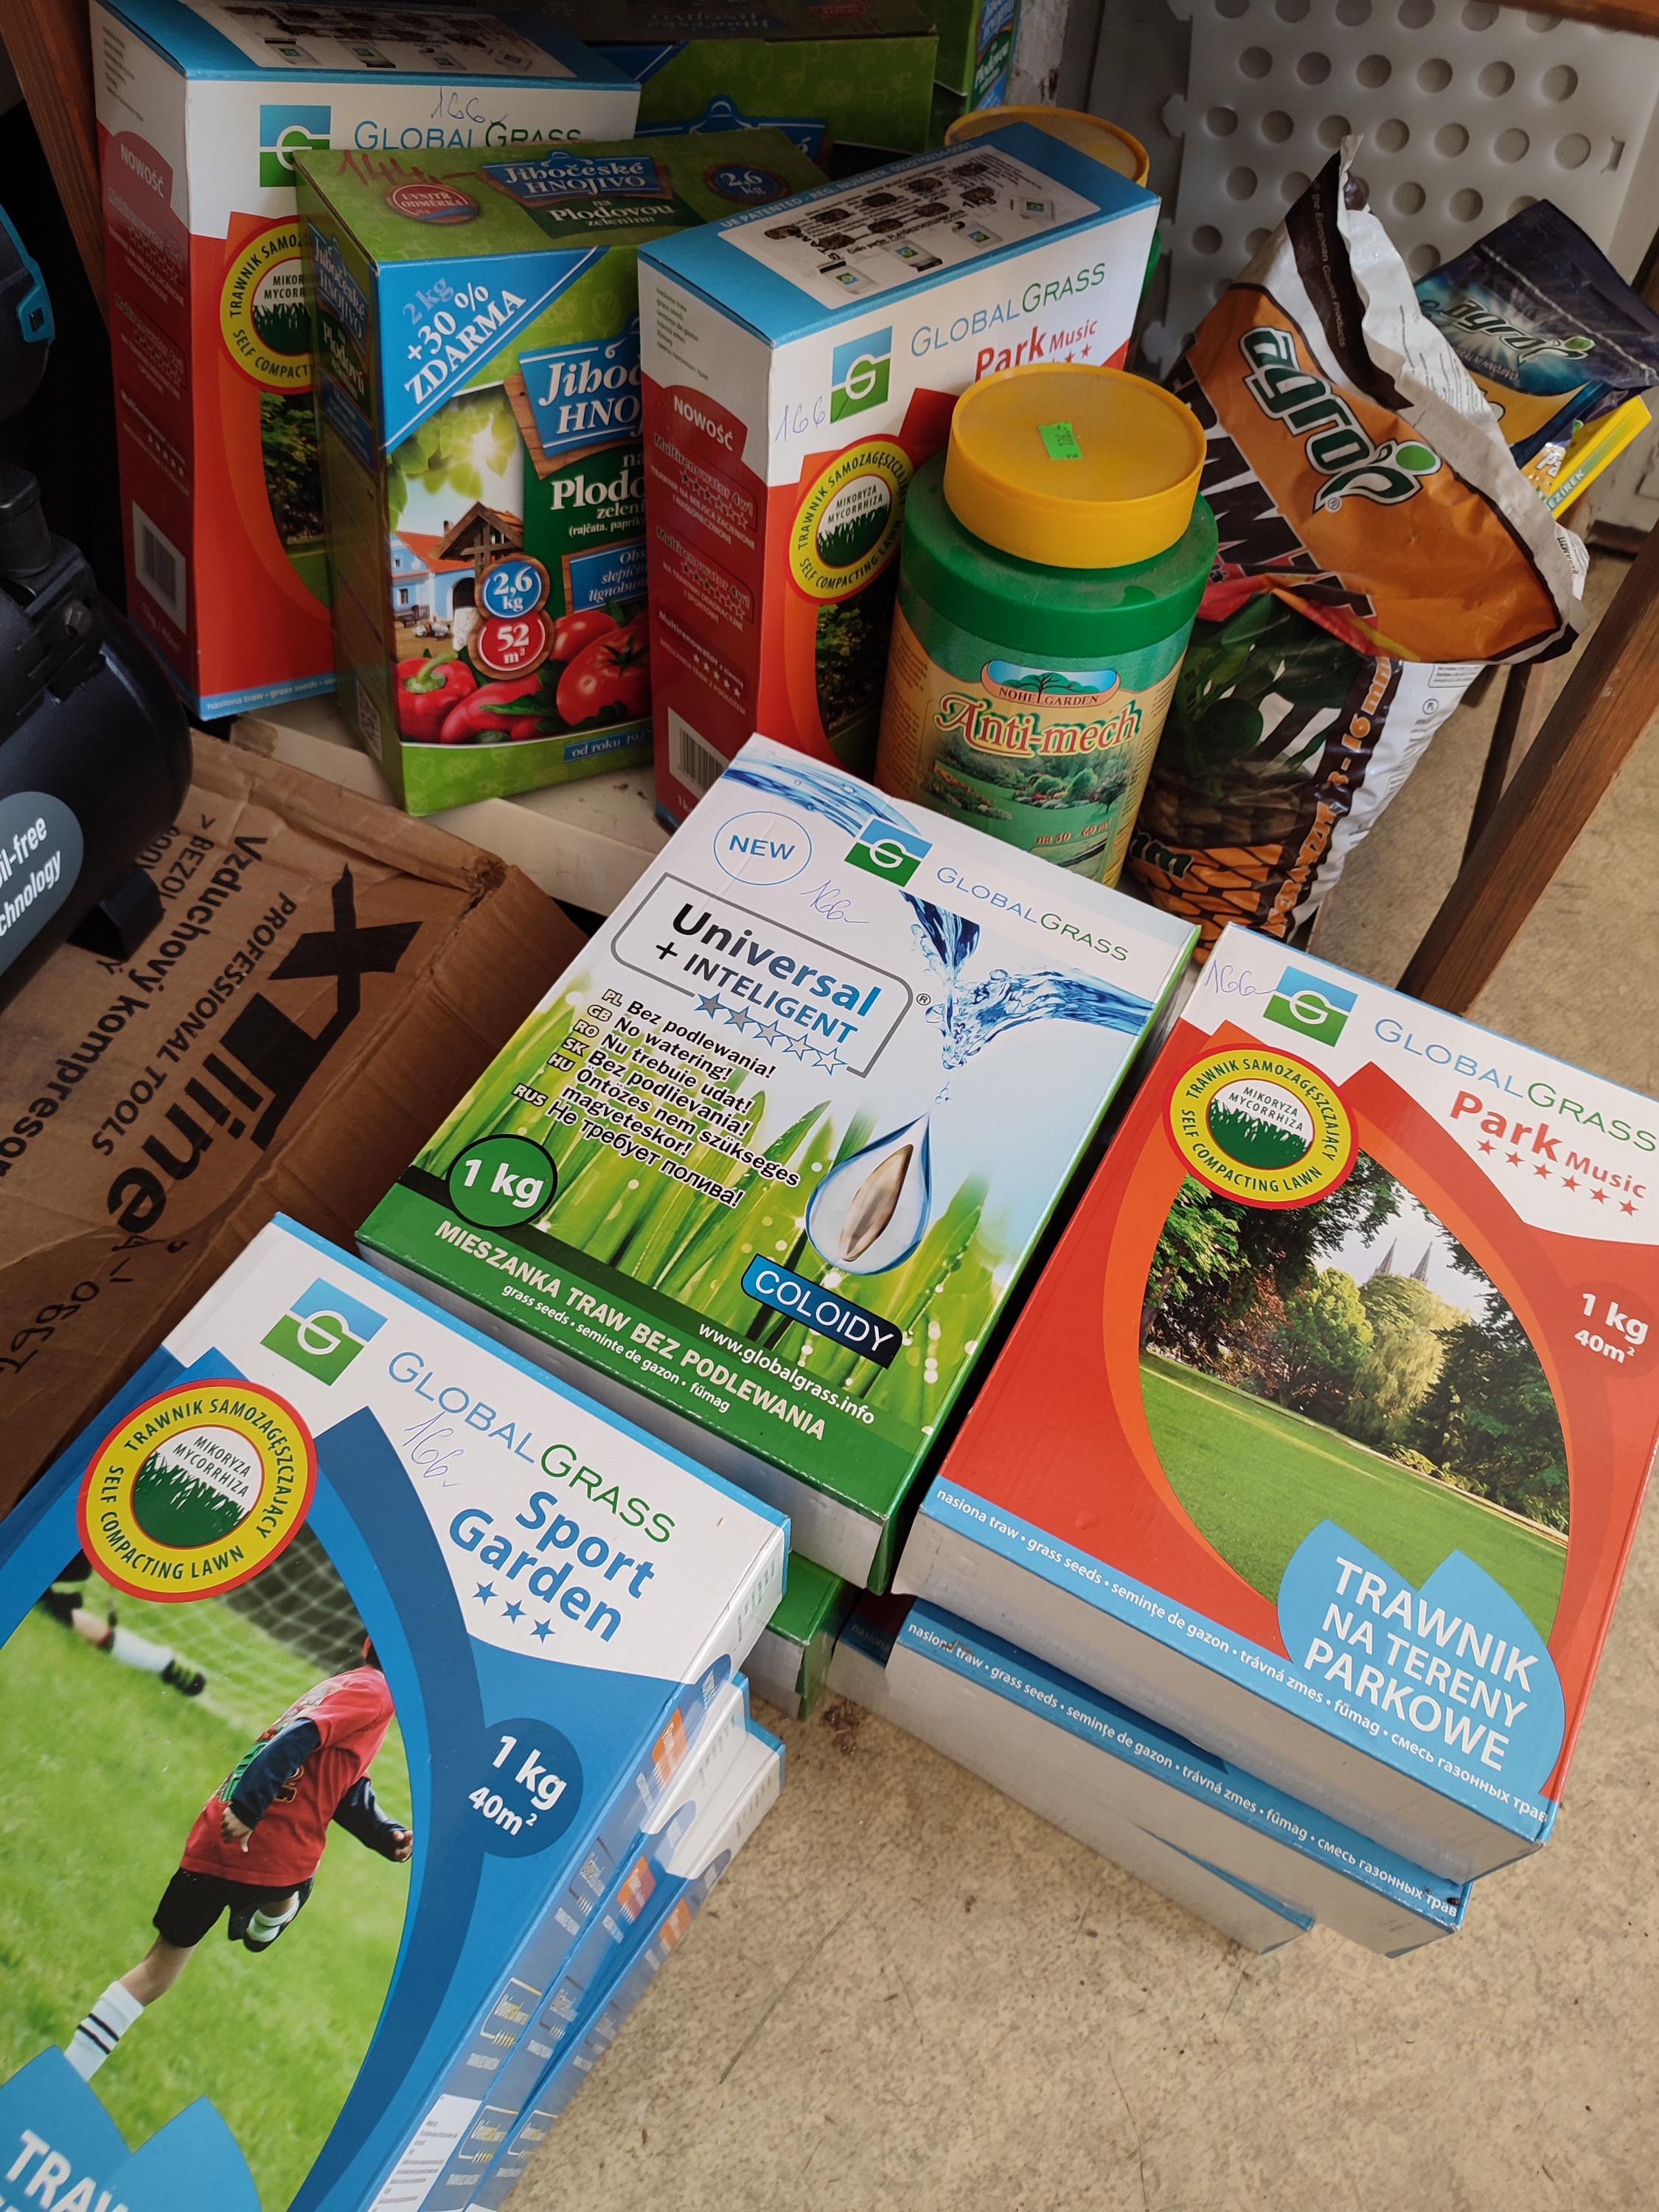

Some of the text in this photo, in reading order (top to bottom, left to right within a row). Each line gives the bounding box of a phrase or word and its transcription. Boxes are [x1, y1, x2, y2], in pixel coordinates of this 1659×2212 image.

[120, 142, 165, 198] NOWOŚĆ
[503, 161, 645, 184] Jihočeské
[525, 177, 647, 195] HNOJIVO
[546, 204, 676, 223] Plodovou
[229, 254, 262, 318] TRAWNIK
[403, 277, 455, 326] 2 kg
[911, 262, 1106, 358] GLOBALGRASS
[1332, 301, 1346, 348] Products
[233, 329, 257, 358] SELF
[404, 289, 527, 406] ZDARMA
[407, 310, 457, 361] +30
[975, 318, 1098, 382] Park Music
[674, 394, 734, 452] NOWOŚĆ
[774, 396, 827, 442] 166
[550, 470, 646, 511] Plodo
[798, 487, 829, 552] TRAWNIK
[827, 493, 883, 525] MYCORRHIZA
[836, 485, 877, 509] MIKORYZA
[492, 566, 535, 599] 2,6
[503, 596, 524, 613] kg
[800, 557, 818, 582] SELF
[815, 555, 879, 590] COMPACTING
[496, 623, 530, 653] 52
[935, 696, 1143, 758] Anti-mech
[1045, 695, 1100, 706] GARDEN
[1341, 712, 1372, 754] 16
[571, 738, 622, 759] od roku
[728, 833, 797, 862] NEW
[0, 849, 61, 937] chnology
[128, 835, 268, 997] Vzduchový
[935, 866, 1130, 963] GLOBALGRASS
[158, 893, 298, 1065] PROFESSIONAL
[672, 902, 883, 1018] Universal
[601, 988, 778, 1080] PL Bez podlewania!
[681, 954, 860, 1046] INTELIGENT
[572, 1019, 756, 1116] RO Nu trebuie udat!
[586, 1004, 736, 1083] GB No watering!
[91, 1065, 167, 1158] TOOLS
[511, 1082, 549, 1108] RUS
[547, 1051, 801, 1189] HU Öntözes nem szükseges
[560, 1036, 753, 1138] SK Bez podlievania!
[560, 1084, 695, 1160] magveteskor!
[1185, 1057, 1341, 1162] TRAWNIK SAMOZAGĘSZCZAJĄCY
[1228, 1091, 1305, 1133] MYCORRHIZA
[1242, 1085, 1300, 1119] MIKORYZA
[1374, 1017, 1658, 1154] GLOBALGRASS
[545, 1099, 747, 1210] Не требует полива!
[1180, 1107, 1324, 1193] SELF COMPACTING LAWN
[1448, 1089, 1648, 1200] Park Music
[462, 1157, 546, 1211] 1 kg
[434, 1219, 828, 1442] MIESZANKA TRAW BEZ PODLEWANIA
[500, 1282, 535, 1308] grass
[534, 1300, 571, 1326] seeds
[576, 1320, 625, 1357] seminte
[624, 1346, 641, 1365] de
[640, 1356, 681, 1388] gazon
[753, 1268, 897, 1354] COLOIDY
[1581, 1292, 1649, 1346] 1 kg
[698, 1322, 877, 1426] www.globalgrass.info
[122, 1397, 295, 1541] TRAWNIK SAMOZAGĘSZCZAJĄCY
[171, 1441, 251, 1499] MYCORRHIZA
[192, 1434, 253, 1478] MIKORYZA
[388, 1350, 678, 1545] GLOBALGRASS
[99, 1464, 246, 1580] SELF COMPACTING LAWN
[515, 1489, 657, 1601] Sport
[448, 1506, 625, 1645] Garden
[935, 1486, 988, 1525] nasiona
[987, 1515, 1020, 1541] traw
[1026, 1536, 1063, 1564] grass
[1063, 1554, 1104, 1586] seeds
[1166, 1611, 1187, 1631] de
[1186, 1623, 1231, 1655] gazon
[1239, 1648, 1286, 1684] trávná
[1285, 1674, 1325, 1705] zmes
[1332, 1698, 1382, 1737] fűmag
[1390, 1731, 1436, 1764] смесь
[1436, 1756, 1513, 1806] газонных
[1512, 1795, 1548, 1825] трав
[1334, 1555, 1540, 1694] TRAWNIK
[1302, 1635, 1512, 1773] PARKOWE
[1321, 1601, 1529, 1730] NA TERENY
[491, 1734, 568, 1812] 1 kg
[907, 1621, 957, 1655] nasiona
[956, 1645, 985, 1669] traw
[989, 1665, 1023, 1691] grass
[1022, 1681, 1060, 1708] seeds
[1116, 1731, 1134, 1748] de
[1133, 1740, 1174, 1770] gazon
[1180, 1764, 1222, 1796] trávná
[1222, 1787, 1258, 1813] zmes
[1316, 1836, 1357, 1865] смесь
[1357, 1857, 1425, 1902] газонных
[1425, 1893, 1459, 1919] трав
